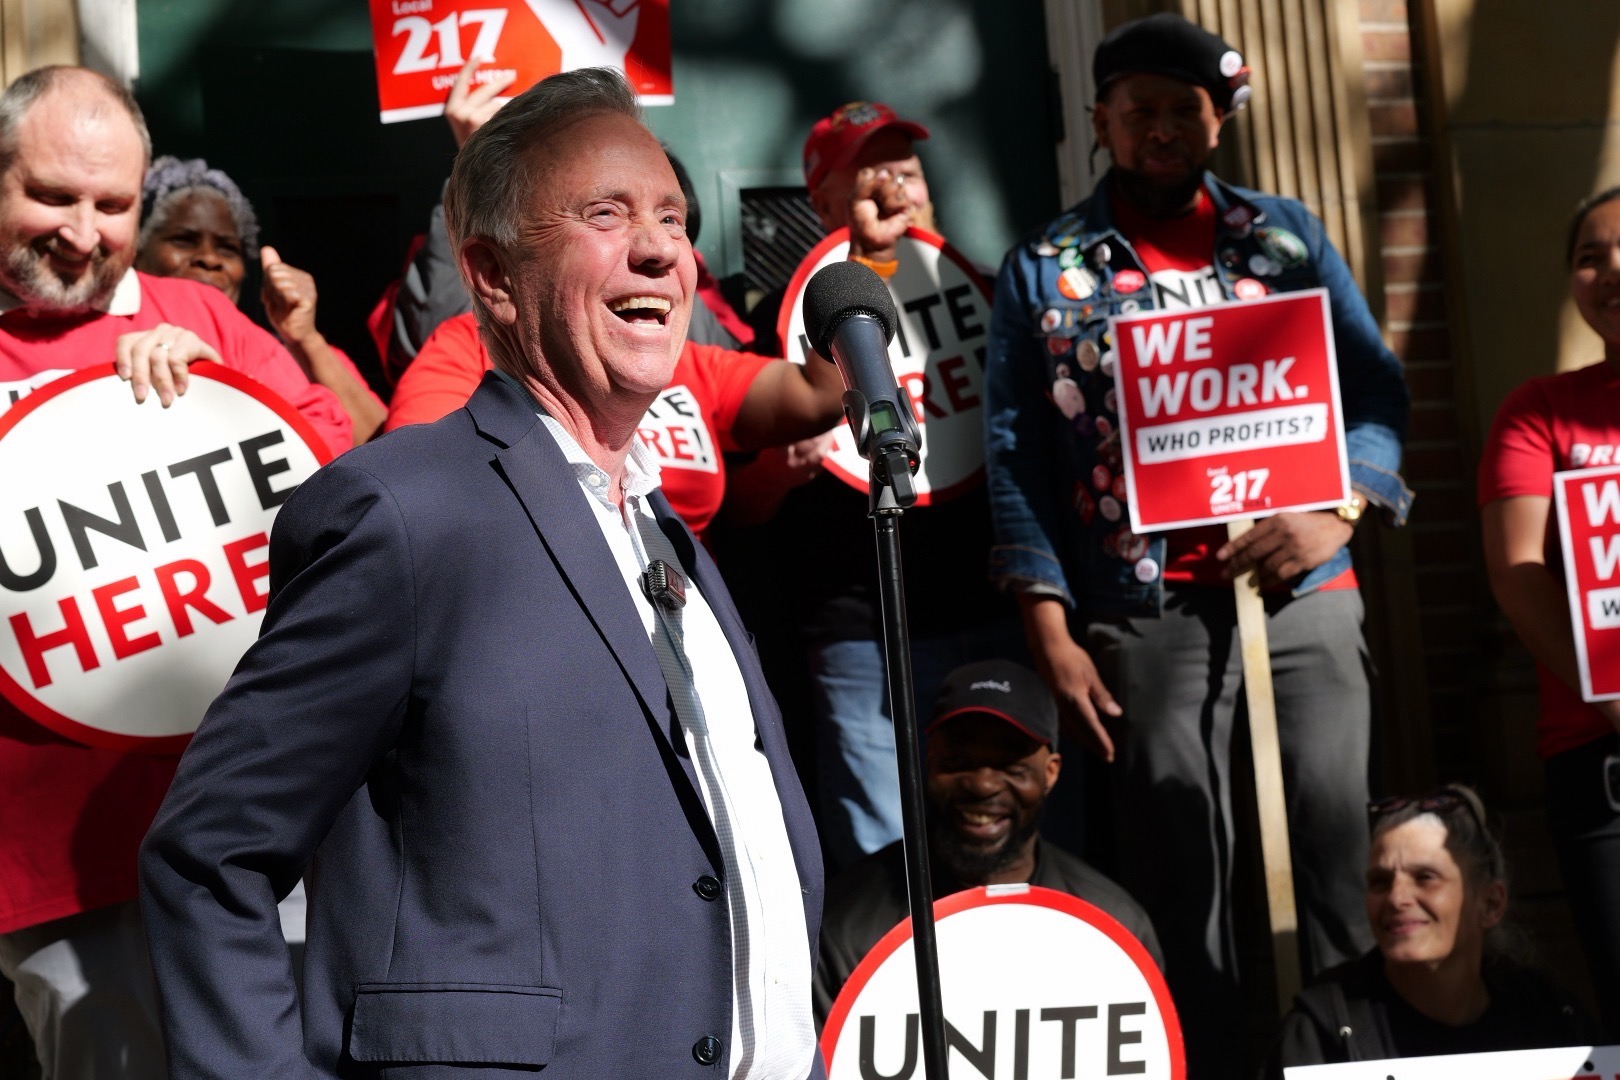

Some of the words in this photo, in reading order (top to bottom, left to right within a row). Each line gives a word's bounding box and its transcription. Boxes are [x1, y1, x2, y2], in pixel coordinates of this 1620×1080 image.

[392, 8, 508, 75] 217
[1131, 316, 1214, 368] WE
[1138, 357, 1309, 418] WORK.
[1147, 431, 1200, 452] WHO
[1209, 416, 1314, 446] PROFITS?
[0, 429, 303, 593] UNITE
[1209, 468, 1270, 504] 217
[859, 1001, 1147, 1080] UNITE
